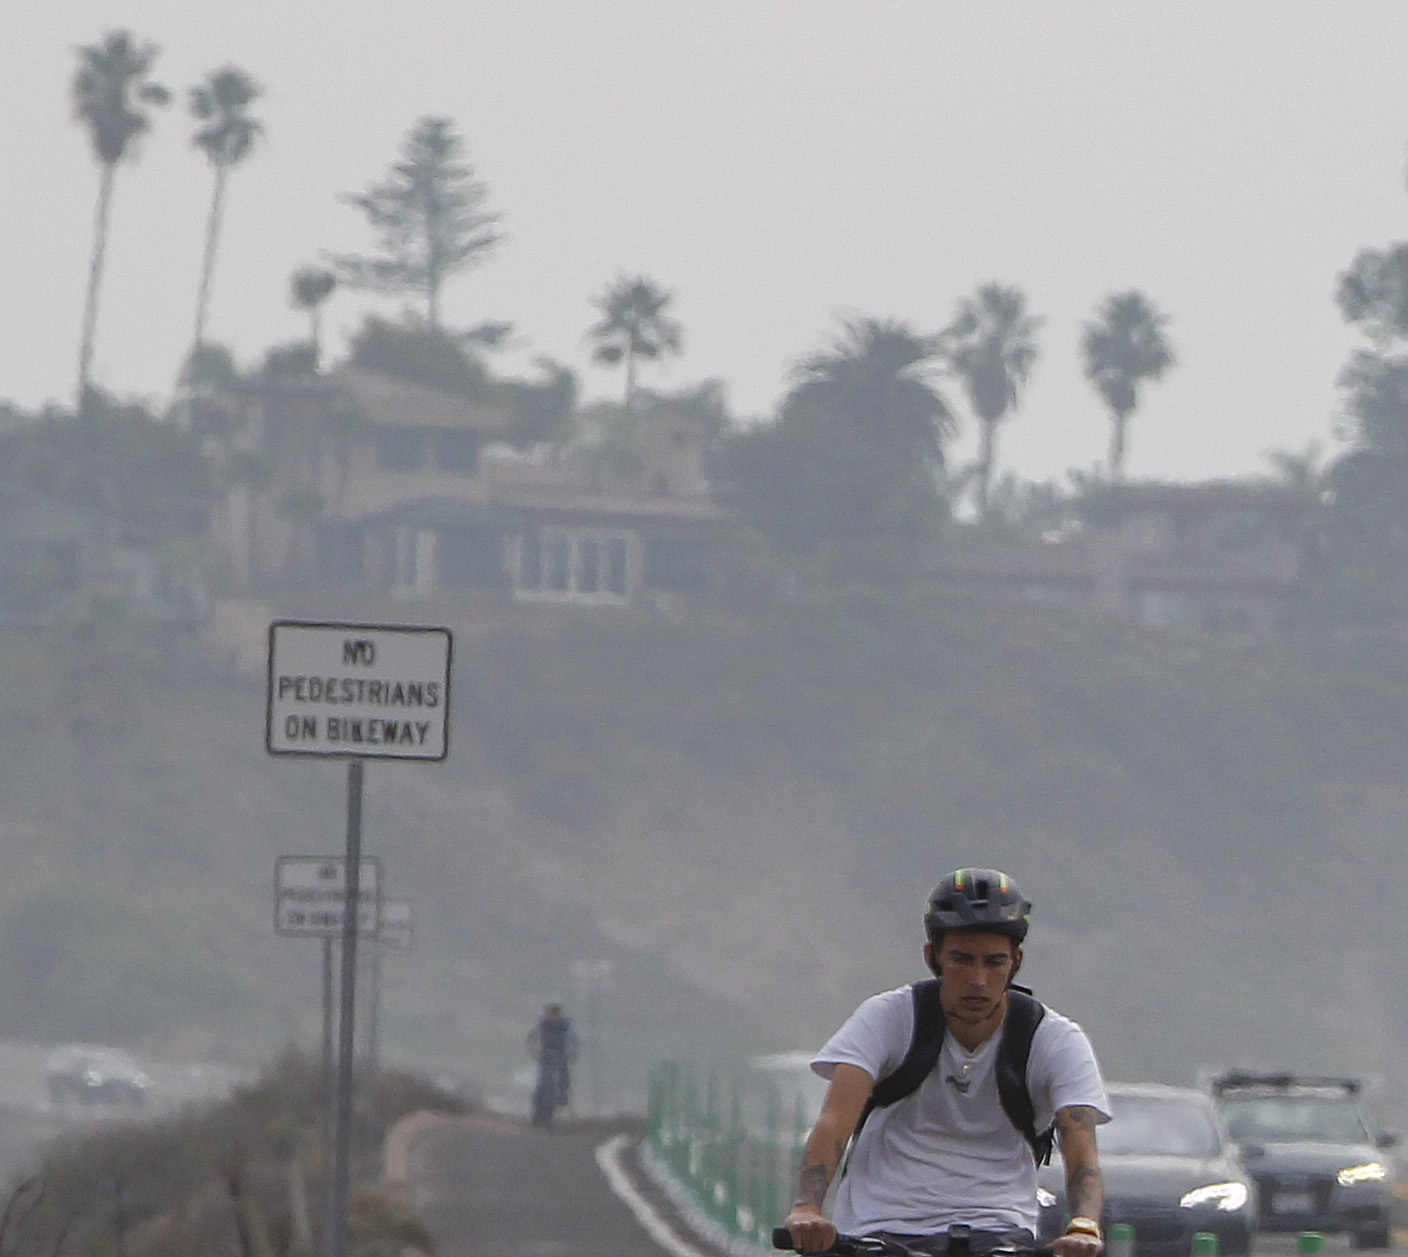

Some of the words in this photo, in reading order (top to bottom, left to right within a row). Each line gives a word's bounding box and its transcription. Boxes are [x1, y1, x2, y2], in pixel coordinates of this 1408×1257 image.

[343, 639, 376, 666] NO
[279, 675, 439, 708] PEDESTRIANS
[286, 714, 317, 740] ON
[327, 718, 428, 746] BIKEWAY
